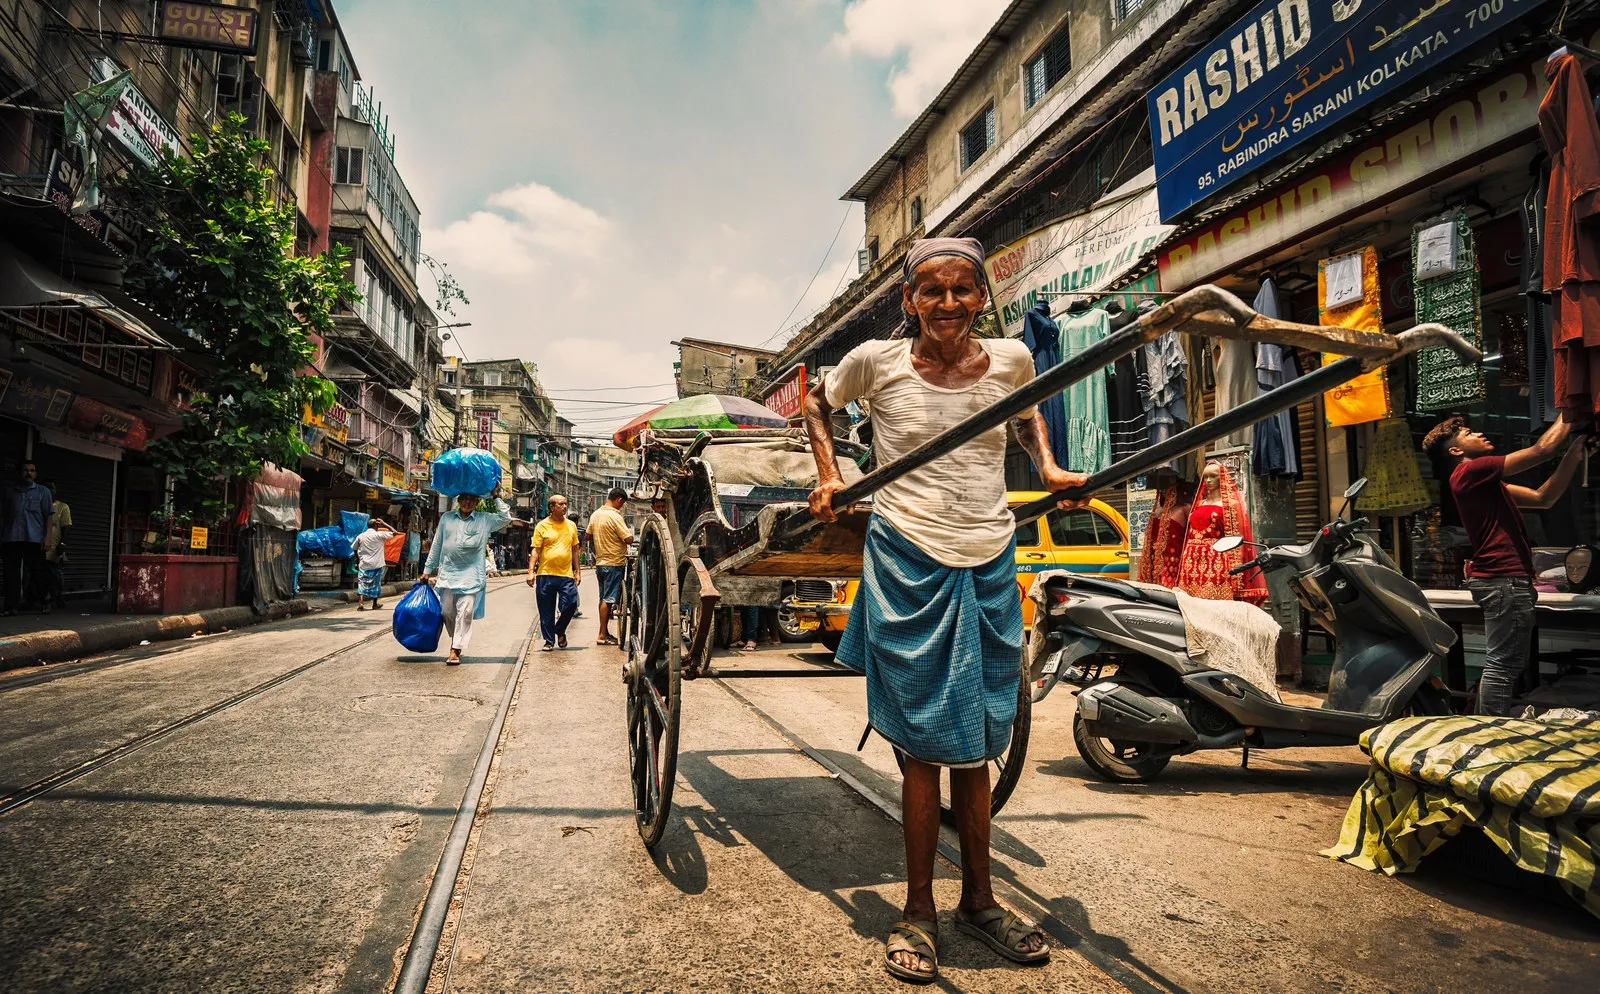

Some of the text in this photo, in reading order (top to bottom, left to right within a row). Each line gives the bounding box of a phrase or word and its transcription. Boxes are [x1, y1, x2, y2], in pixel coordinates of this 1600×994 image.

[162, 21, 250, 47] HOUSE
[167, 4, 252, 27] GUEST
[1156, 0, 1311, 146] RASHID
[1197, 171, 1215, 190] 95,
[1217, 127, 1289, 178] RABINDRA
[1291, 85, 1353, 133] SARANI
[1357, 30, 1448, 96] KOLKATA
[1465, 0, 1504, 30] 700
[119, 80, 174, 143] ANDARD
[136, 142, 156, 164] FLOOR
[1168, 178, 1333, 268] RASHID
[1002, 288, 1038, 326] ASLAM
[1060, 260, 1111, 293] ALAM
[765, 376, 800, 412] SHAMIM
